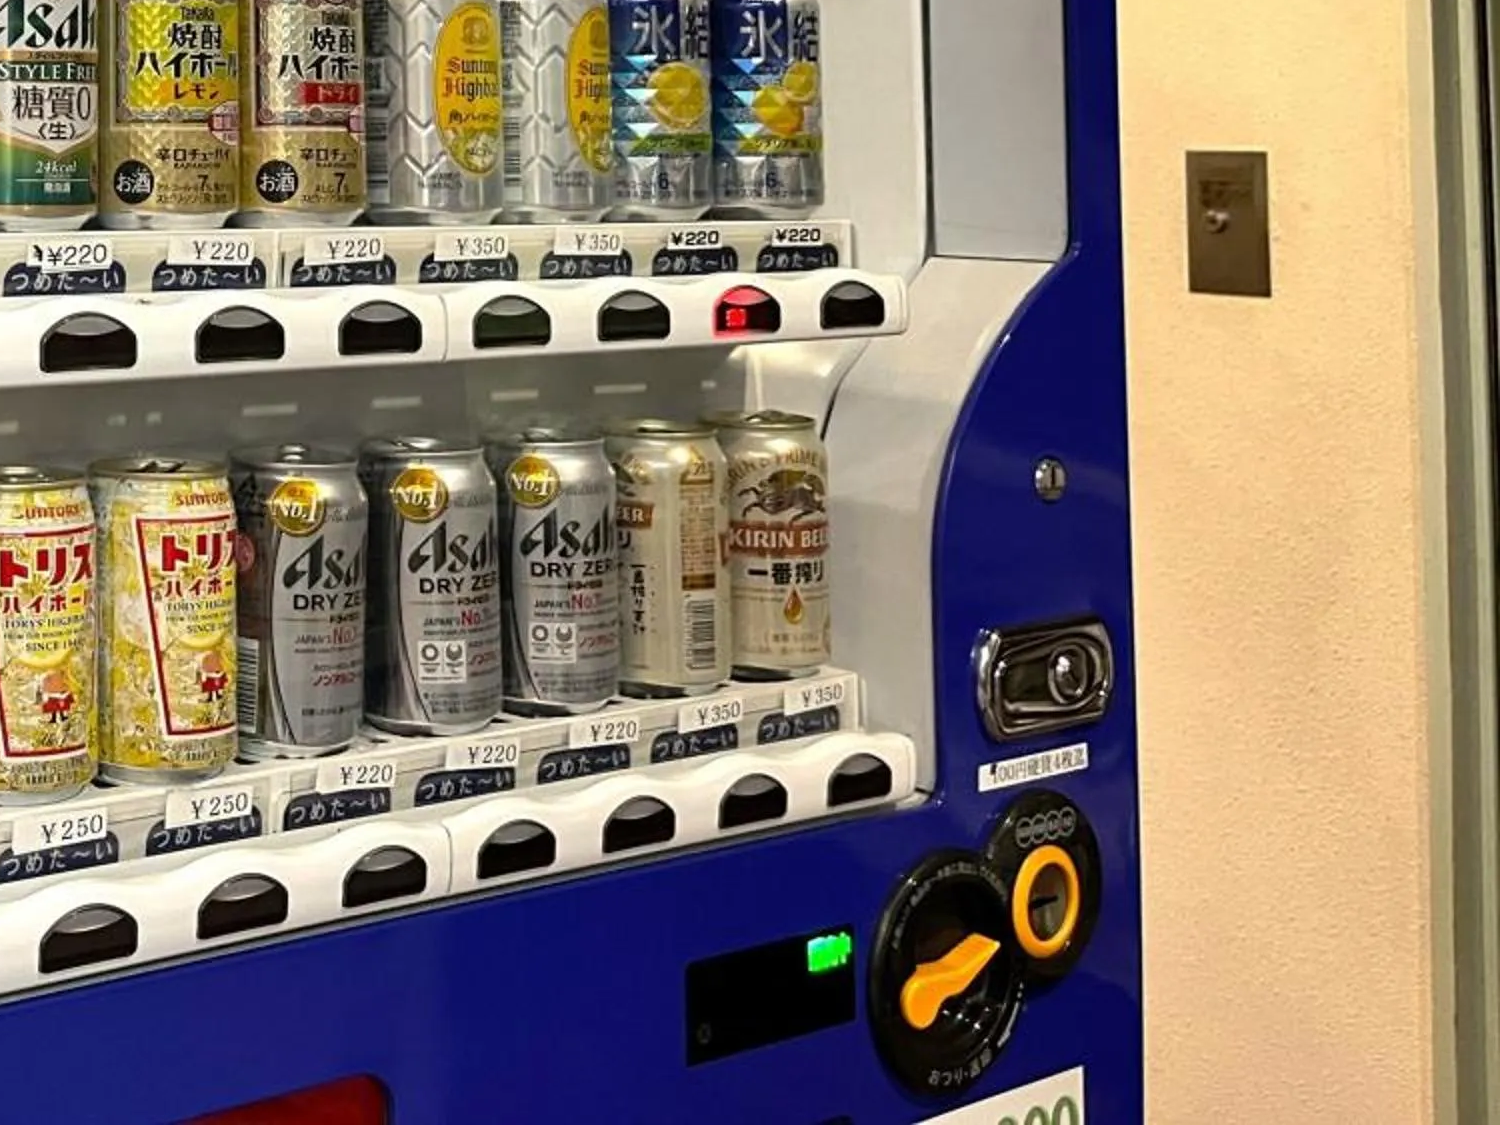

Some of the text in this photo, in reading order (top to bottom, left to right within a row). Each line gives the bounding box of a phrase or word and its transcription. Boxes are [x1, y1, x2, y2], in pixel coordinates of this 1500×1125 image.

[168, 22, 222, 50] 焼酎
[739, 9, 818, 62] 氷結
[173, 82, 221, 101] レモン
[12, 86, 92, 121] 糖質0
[116, 168, 151, 194] お酒
[260, 168, 296, 194] お酒
[456, 236, 505, 256] ¥350
[574, 233, 620, 252] ¥350
[671, 230, 719, 246] ¥220
[775, 228, 821, 243] ¥220
[47, 243, 108, 266] ¥220
[192, 239, 250, 261] ¥220
[327, 239, 380, 260] ¥220
[729, 528, 795, 549] KIRIN
[531, 560, 576, 578] DRY
[748, 559, 824, 585] 一番搾り
[419, 577, 466, 595] DRY
[293, 593, 339, 613] DRY
[803, 684, 843, 708] ¥350
[698, 700, 741, 726] ¥350
[590, 721, 637, 742] ¥220
[467, 745, 517, 765] ¥220
[340, 765, 393, 786] ¥220
[190, 791, 249, 820] ¥250
[42, 814, 103, 844] ¥250
